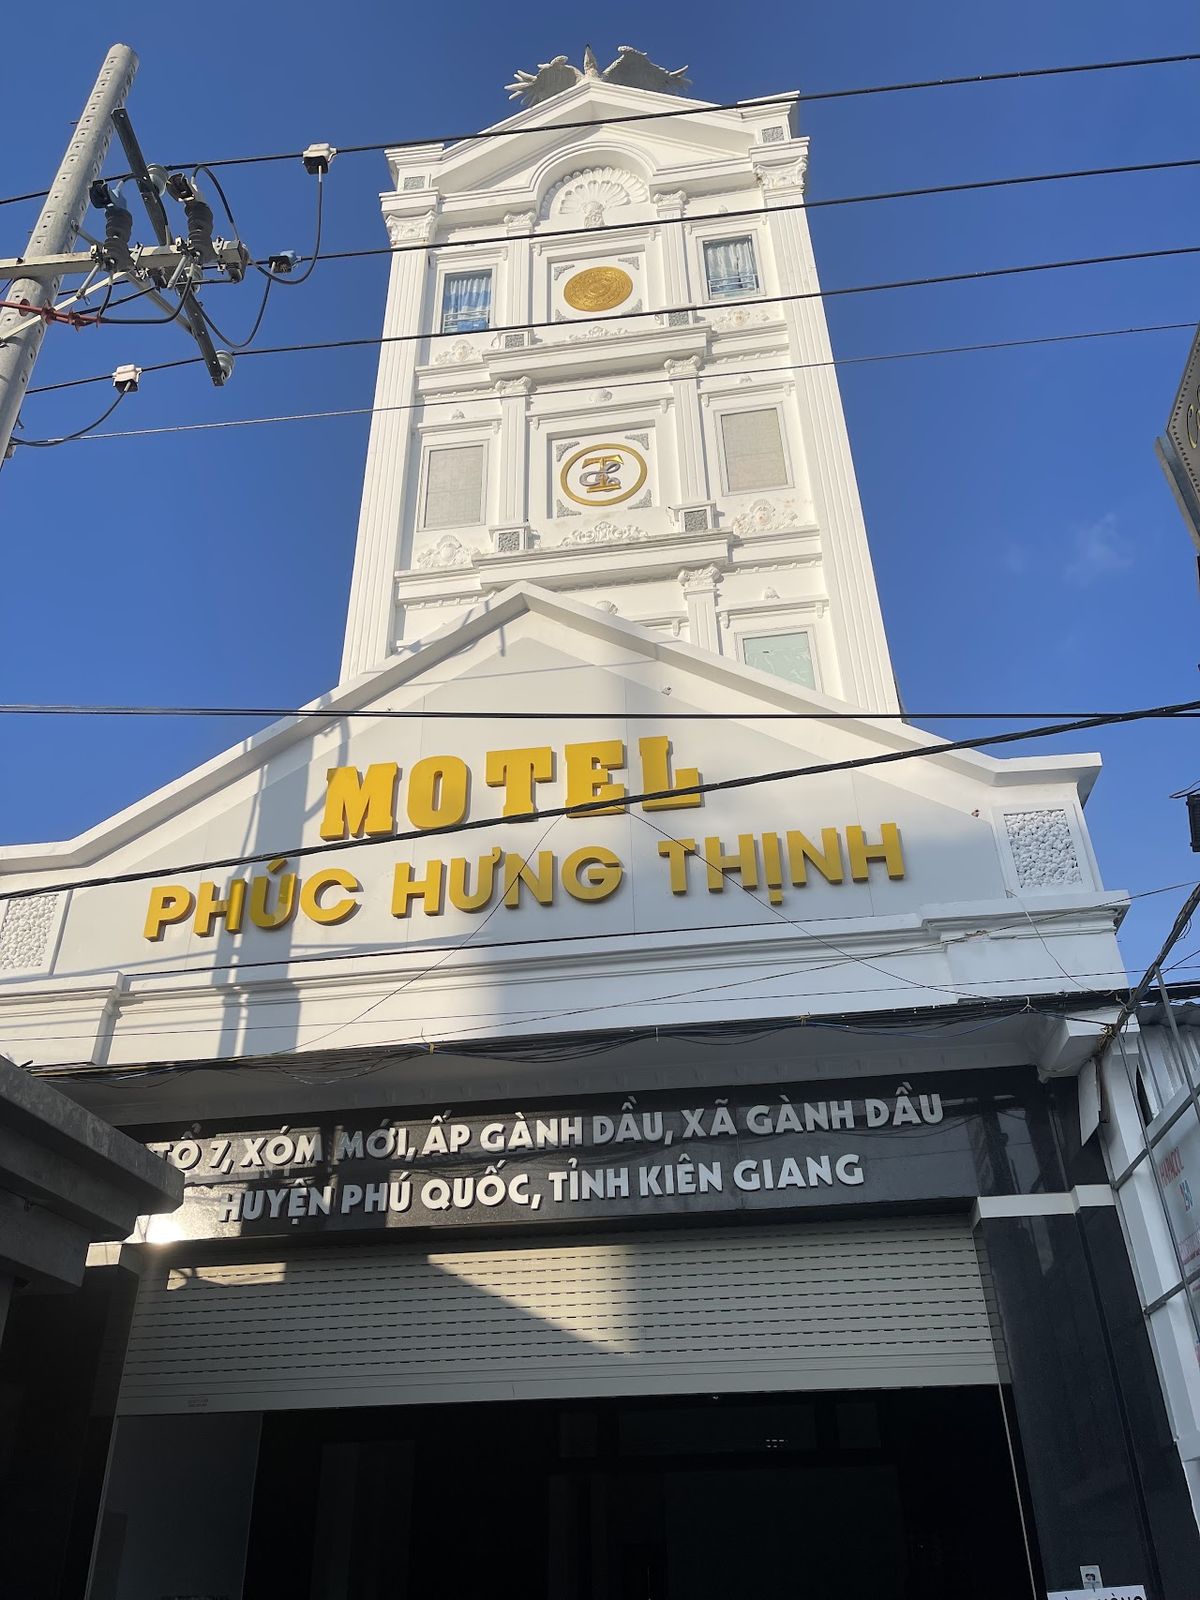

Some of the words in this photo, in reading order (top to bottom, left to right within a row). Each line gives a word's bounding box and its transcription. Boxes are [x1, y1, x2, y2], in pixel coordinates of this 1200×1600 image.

[320, 736, 704, 841] MOTEL
[144, 859, 361, 942] PHÚC
[391, 846, 623, 918] HƯNG
[658, 822, 904, 906] THỊNH
[209, 1139, 235, 1174] 7,
[239, 1125, 323, 1167] XÓM
[336, 1118, 416, 1162] MỚI,
[421, 1109, 471, 1156] ẤP
[480, 1112, 583, 1152] GÀNH
[592, 1096, 674, 1146] DẦU,
[681, 1098, 738, 1139] XÃ
[746, 1094, 855, 1135] GÀNH
[864, 1081, 944, 1128] DẦU
[219, 1178, 333, 1225] HUYỆN
[340, 1171, 412, 1214] PHÚ
[420, 1159, 542, 1210] QUỐC,
[549, 1157, 629, 1202] TỈNH
[639, 1153, 723, 1197] KIÊN
[733, 1153, 865, 1191] GIANG
